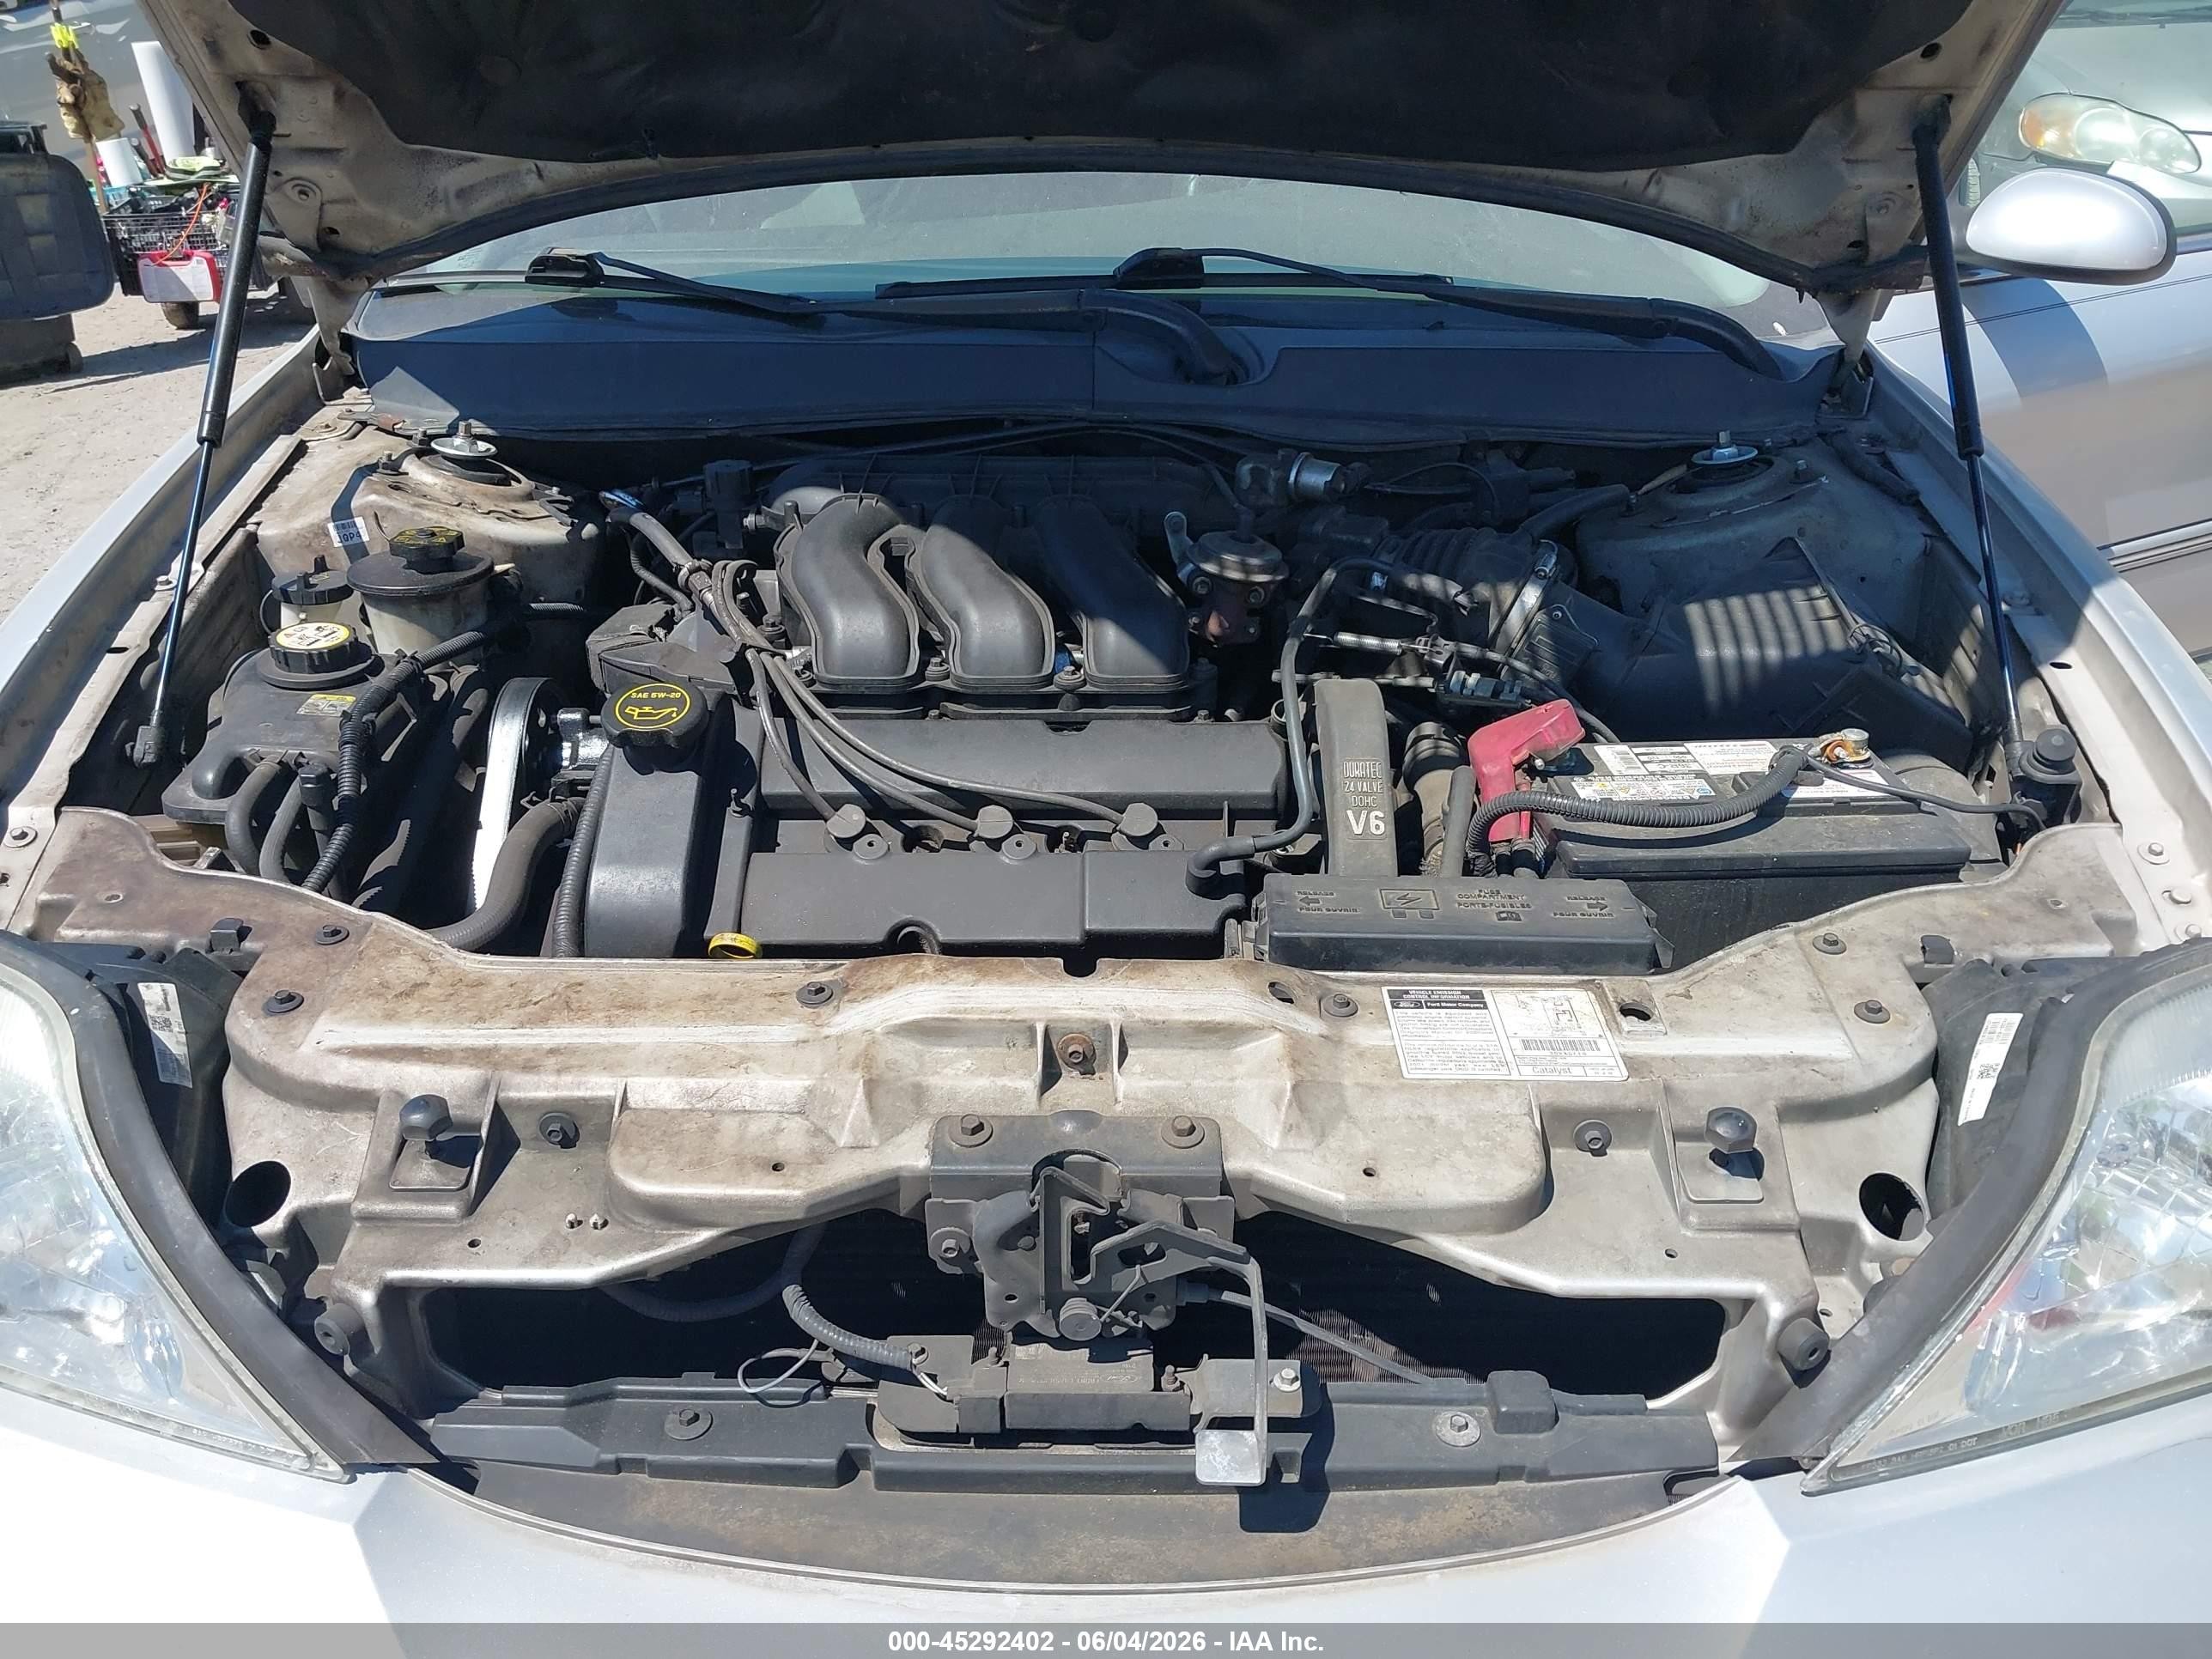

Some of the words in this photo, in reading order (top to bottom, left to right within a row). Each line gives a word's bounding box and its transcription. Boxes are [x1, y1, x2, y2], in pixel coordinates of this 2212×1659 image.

[1343, 761, 1382, 779] DURATEC
[1344, 781, 1355, 793] 24
[1358, 781, 1383, 794] VALVE
[1352, 795, 1378, 808] DOHC
[1346, 810, 1385, 836] V6
[1532, 1066, 1573, 1076] Catalyst
